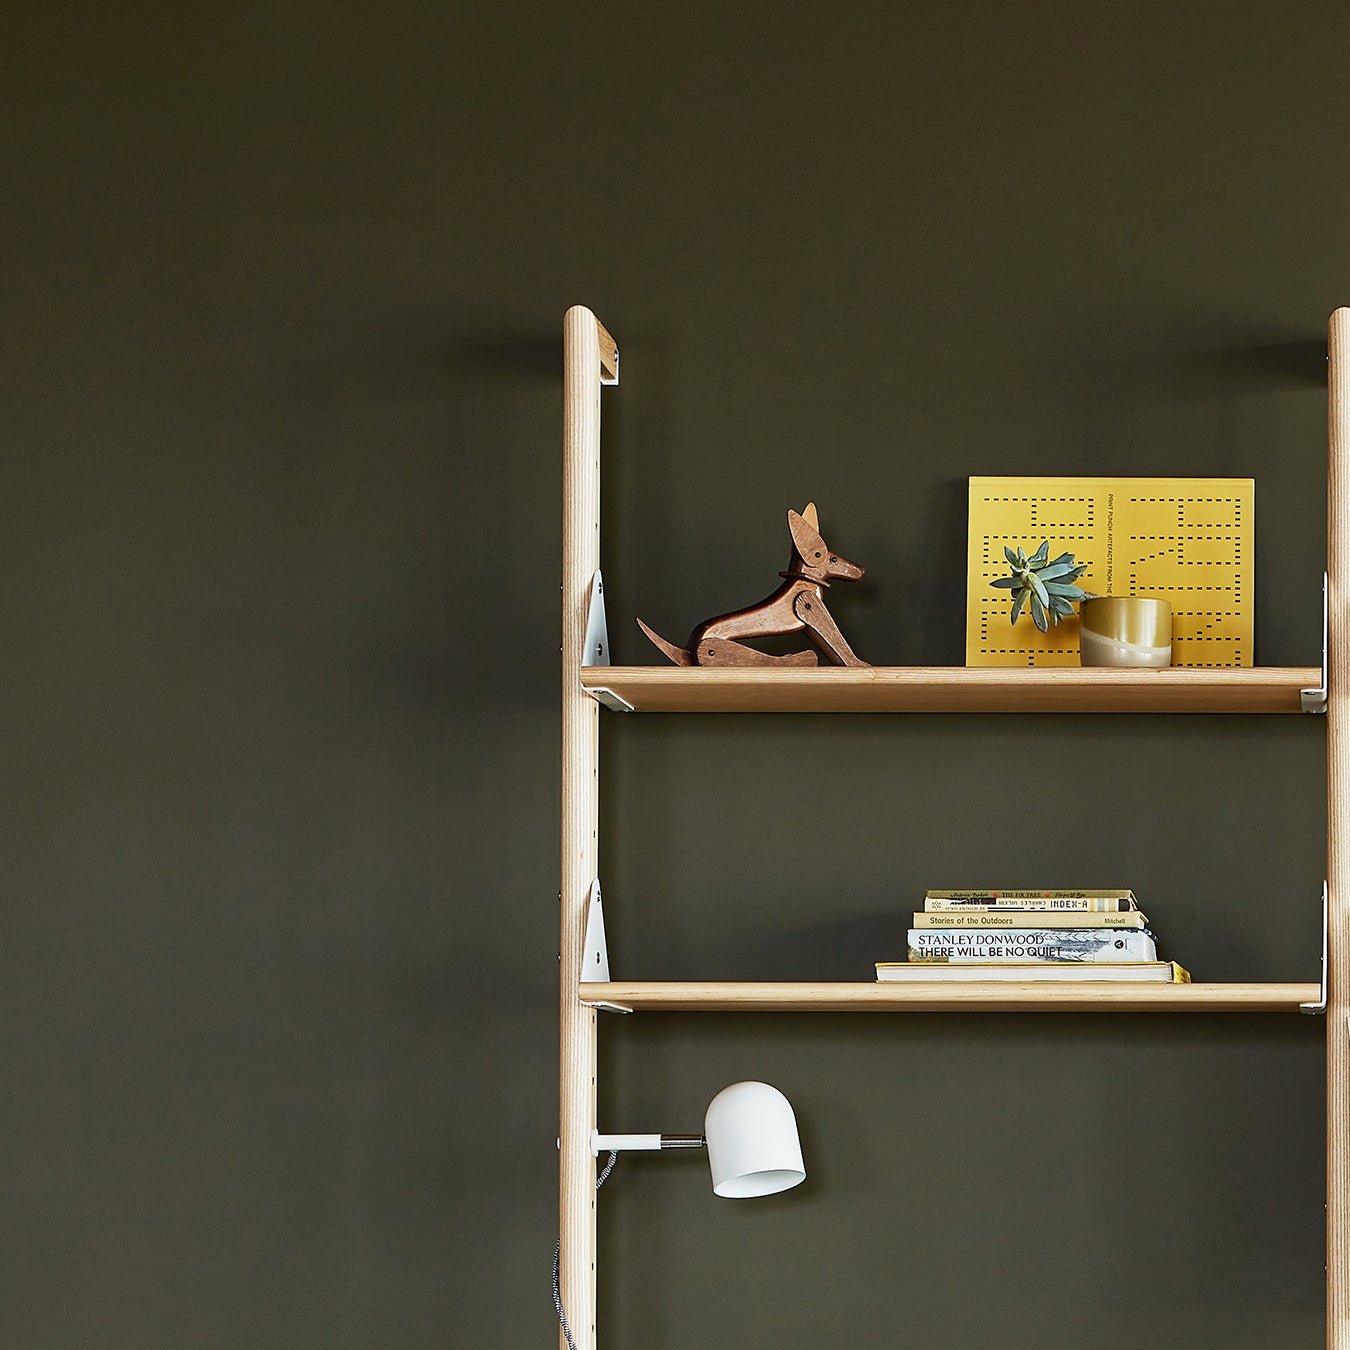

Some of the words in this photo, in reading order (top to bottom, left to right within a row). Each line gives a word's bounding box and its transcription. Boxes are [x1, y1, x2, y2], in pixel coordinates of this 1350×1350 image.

[1050, 900, 1088, 908] INDEX-A
[930, 916, 954, 924] Stories
[957, 916, 965, 924] of
[967, 916, 978, 924] the
[980, 916, 1013, 924] Outdoors
[918, 936, 974, 945] STANLEY
[976, 935, 1044, 945] DONWOOD
[918, 947, 955, 956] THERE
[957, 947, 987, 956] WILL
[989, 947, 1003, 956] BE
[1006, 947, 1024, 956] NO
[1026, 947, 1062, 957] QUIET
